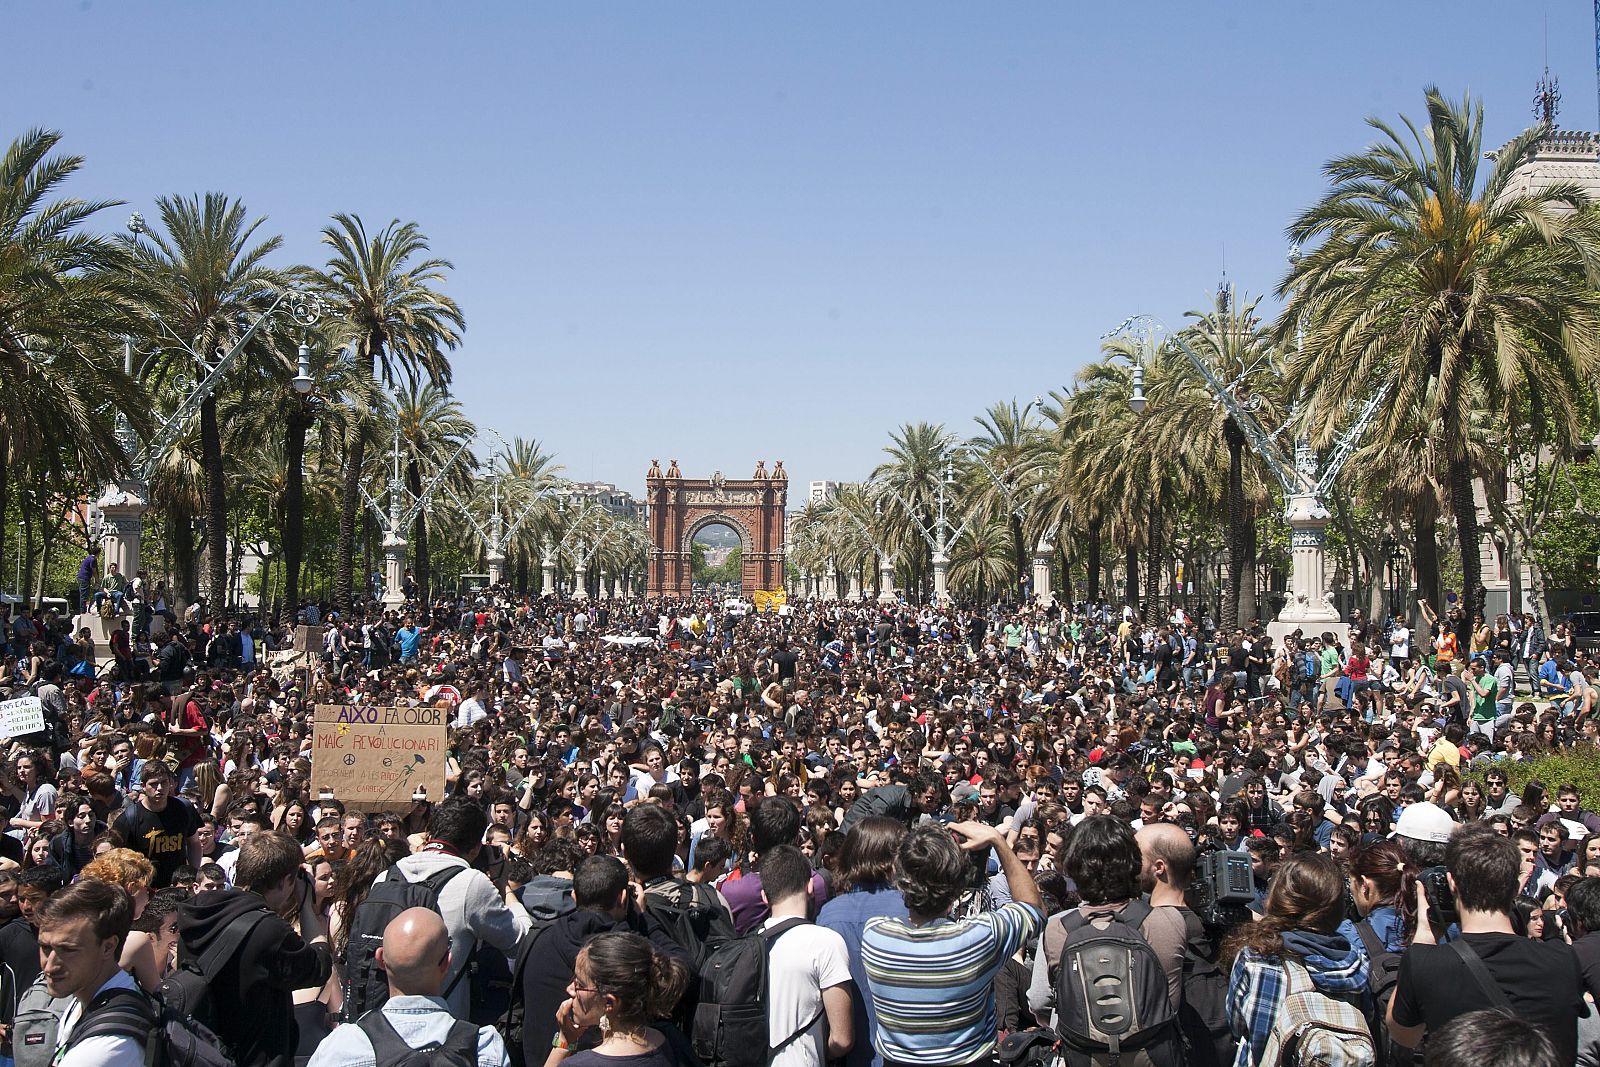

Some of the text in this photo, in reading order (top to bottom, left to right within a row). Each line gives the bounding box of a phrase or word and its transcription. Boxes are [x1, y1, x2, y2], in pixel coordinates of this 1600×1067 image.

[385, 708, 399, 724] FA
[404, 708, 441, 725] OLOR
[379, 725, 386, 736] A
[352, 735, 439, 751] REVOLUCIONARI
[143, 827, 183, 857] Trast
